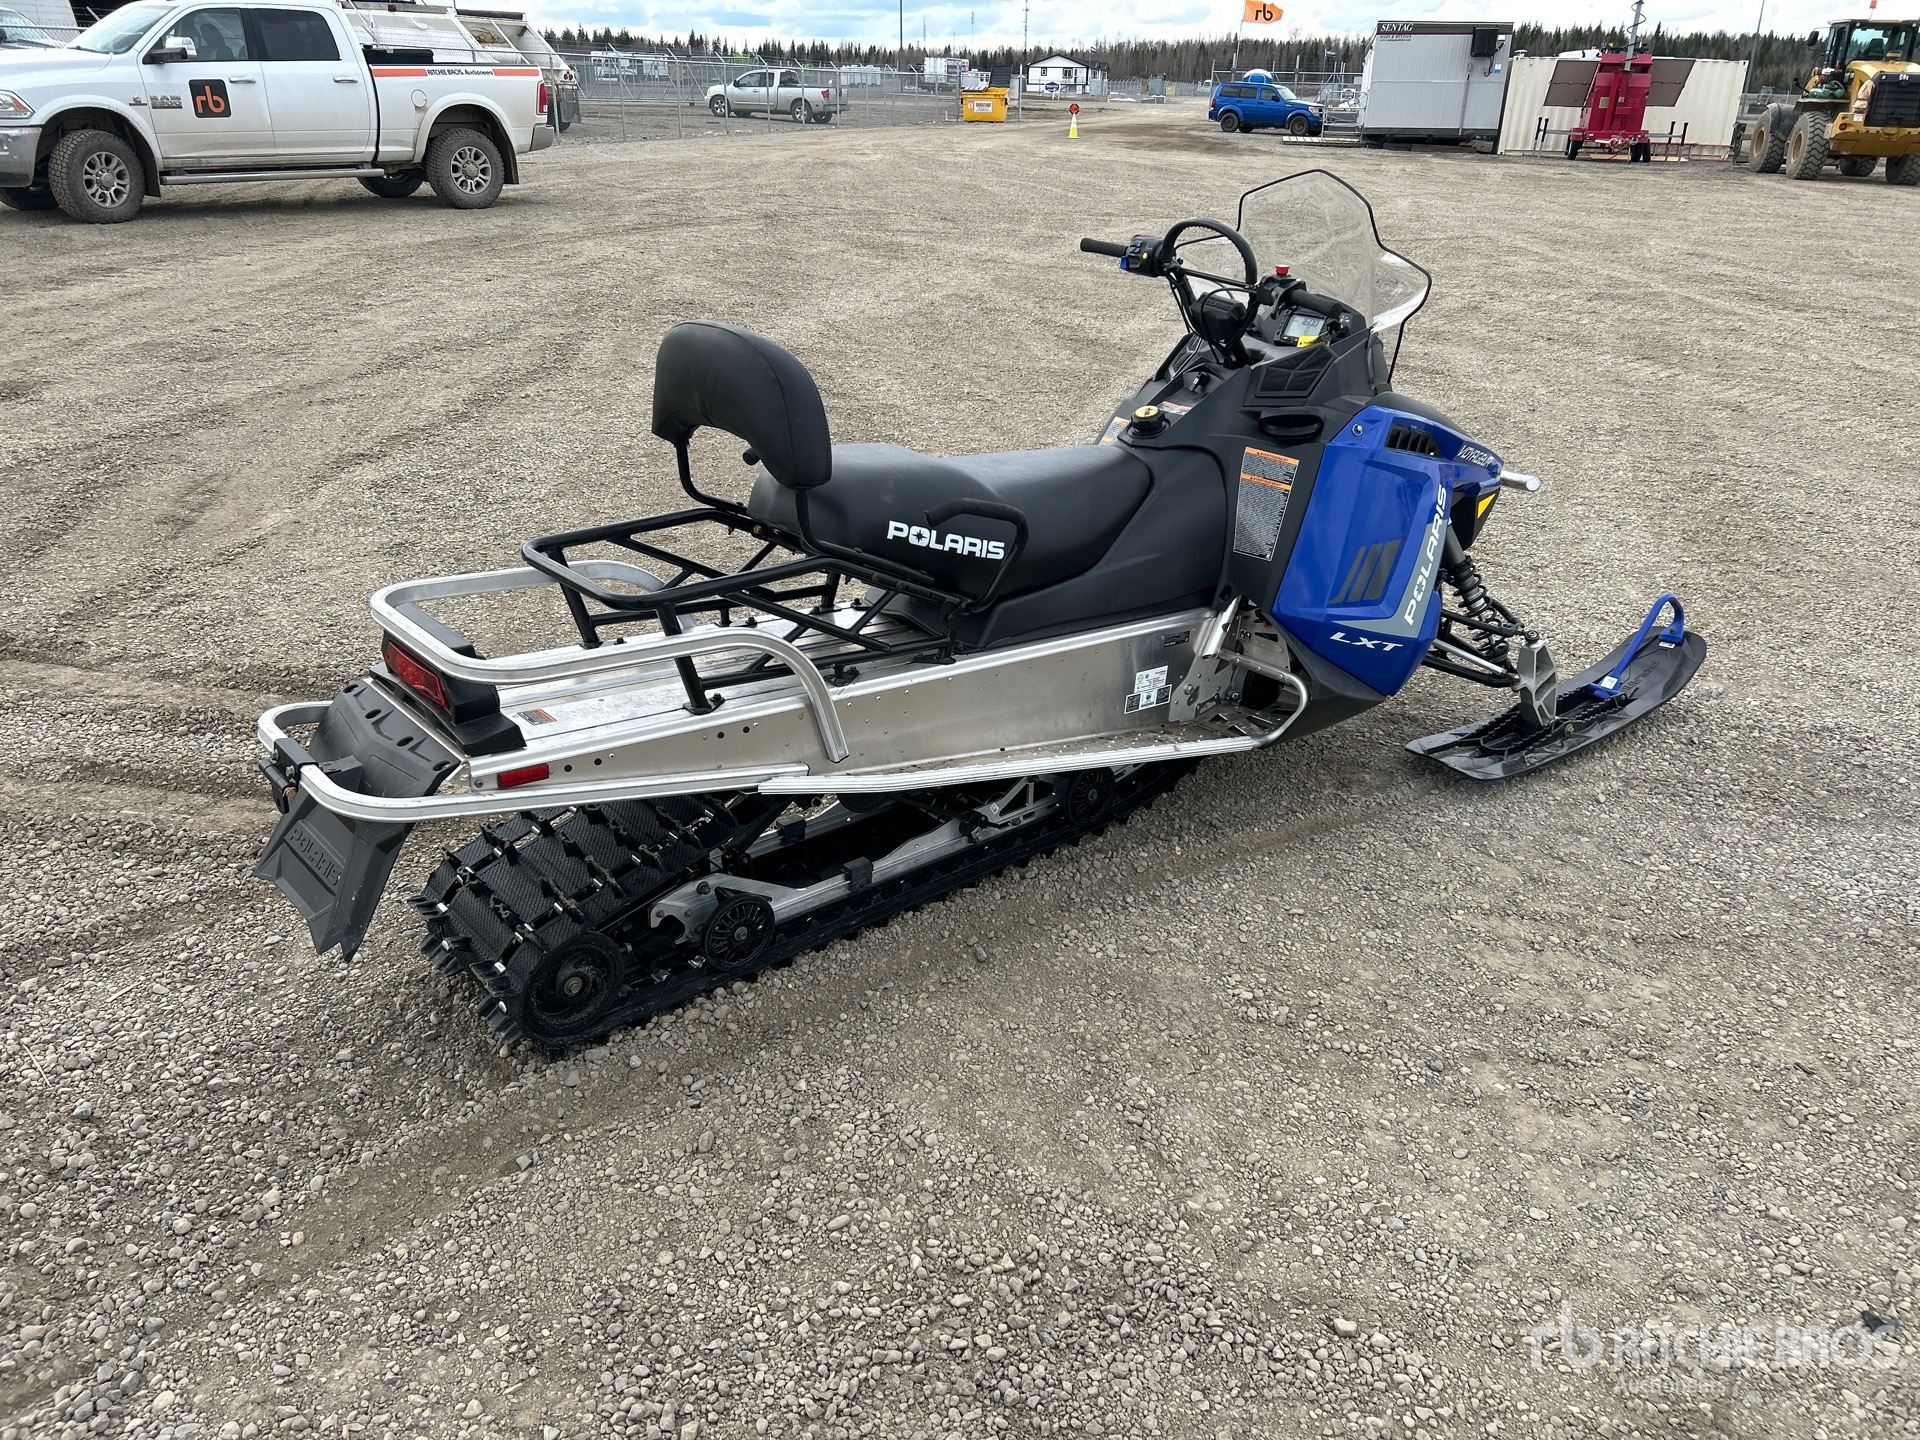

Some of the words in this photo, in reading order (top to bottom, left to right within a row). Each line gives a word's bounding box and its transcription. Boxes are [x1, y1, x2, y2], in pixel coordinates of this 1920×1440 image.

[1255, 3, 1273, 21] rb
[1381, 23, 1413, 32] SENTAG
[196, 85, 226, 113] rb
[886, 520, 1005, 560] POLARIS
[1404, 484, 1447, 626] POLARIS
[1330, 632, 1404, 651] LXT
